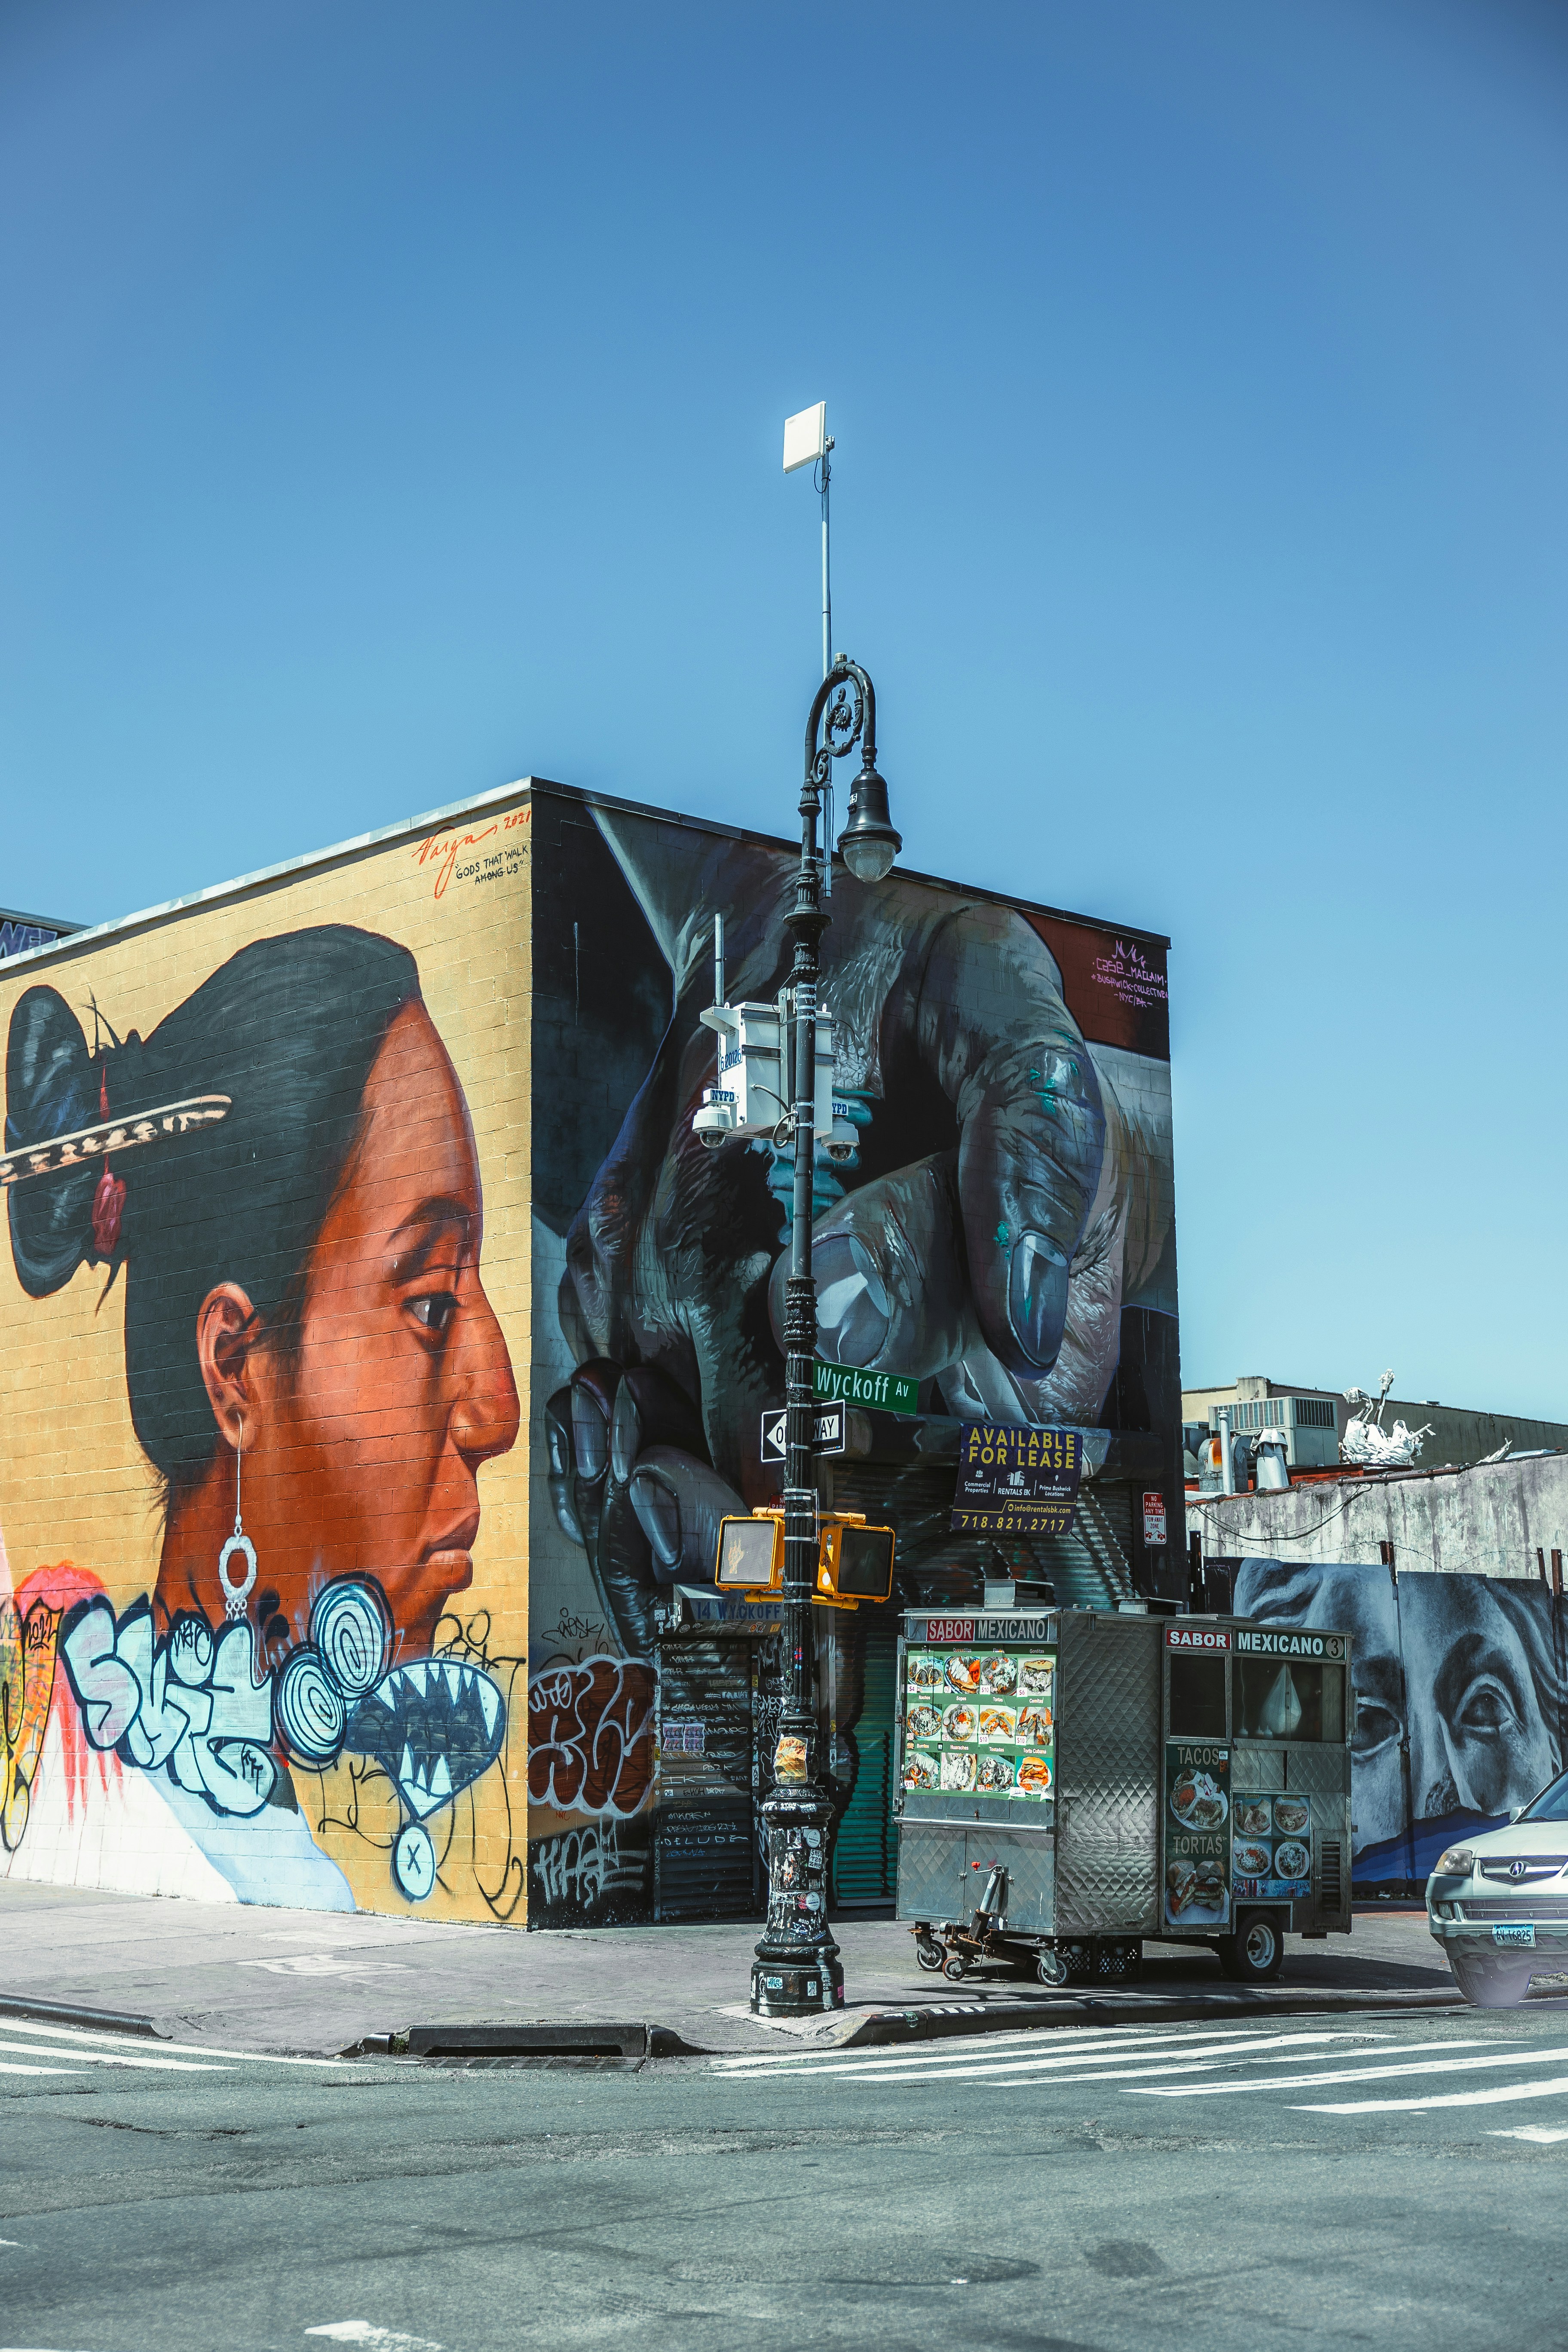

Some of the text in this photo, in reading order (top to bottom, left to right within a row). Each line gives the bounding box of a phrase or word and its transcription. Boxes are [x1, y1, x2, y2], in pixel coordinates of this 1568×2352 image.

[503, 810, 531, 830] 2021
[483, 853, 503, 869] THAT
[505, 845, 529, 861] WALK
[711, 1089, 735, 1102] NYPD
[832, 1102, 847, 1114] YPD
[817, 1366, 909, 1402] Wyckoff Av
[969, 1427, 1075, 1450] AVAILABLE
[968, 1446, 1075, 1469] FOR LEASE
[998, 1488, 1022, 1496] RENTALS
[1014, 1505, 1071, 1514] info@rentalsbk.com
[698, 1601, 781, 1620] 14 WYCKOFF
[929, 1620, 1045, 1639] SABOR MEXICANO
[1170, 1631, 1339, 1657] SABOR MEXICANO 3
[1177, 1747, 1219, 1765] TACOS
[1173, 1836, 1222, 1854] TORTAS
